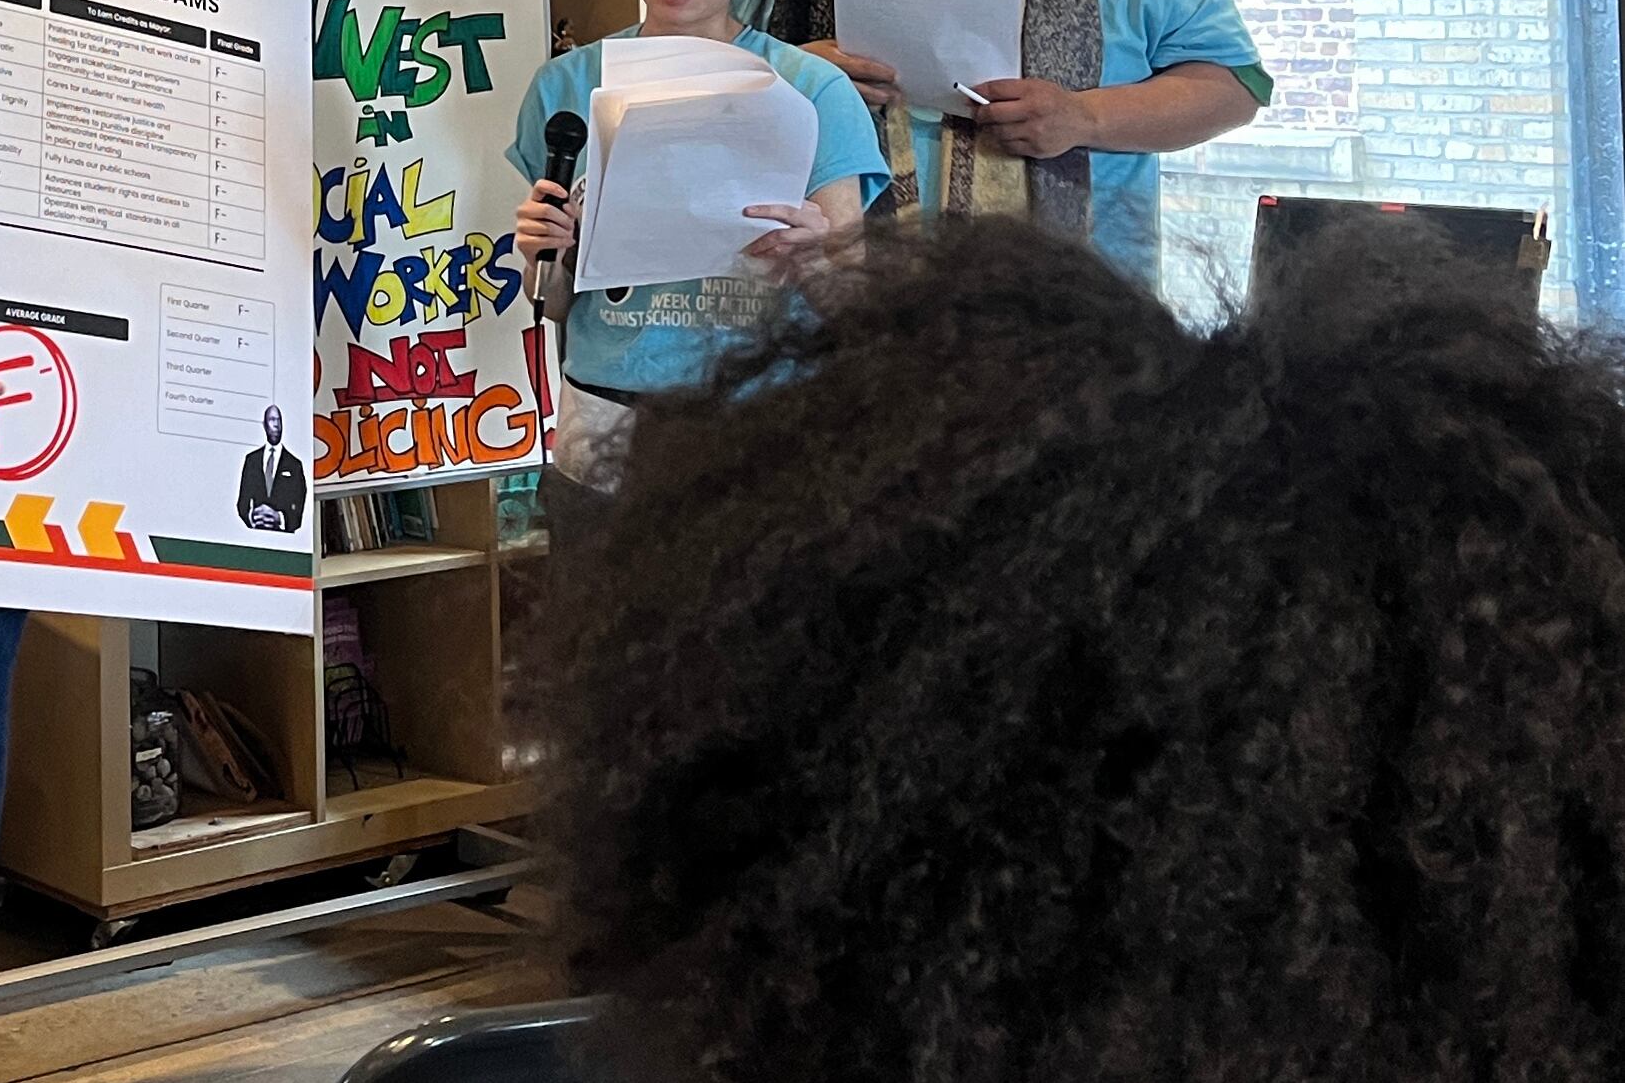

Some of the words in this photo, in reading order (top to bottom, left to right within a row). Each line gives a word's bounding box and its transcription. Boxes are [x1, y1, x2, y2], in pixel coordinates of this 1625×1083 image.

[87, 6, 97, 17] To
[97, 8, 113, 21] Earn
[114, 12, 139, 28] Credits
[139, 20, 148, 29] as
[48, 22, 78, 38] Protects
[80, 30, 104, 43] school
[105, 35, 140, 53] programs
[141, 44, 156, 55] that
[156, 49, 173, 59] work
[174, 52, 189, 62] and
[190, 56, 202, 65] are
[48, 34, 75, 50] healing
[77, 40, 88, 51] for
[89, 43, 120, 58] students
[217, 38, 233, 50] Final
[233, 42, 254, 55] Grade
[48, 49, 80, 65] Engages
[81, 56, 127, 74] stakeholders
[128, 66, 143, 76] and
[143, 71, 180, 87] empowers
[46, 78, 68, 90] Cares
[69, 82, 81, 93] for
[116, 92, 142, 106] mental
[143, 97, 166, 111] health
[106, 71, 131, 84] school
[131, 77, 174, 95] governance
[1, 93, 28, 107] Dignity
[46, 98, 91, 115] Implements
[92, 107, 131, 123] restorative
[132, 116, 156, 129] justice
[156, 122, 171, 132] and
[46, 109, 91, 126] alternatives
[91, 117, 100, 127] to
[100, 120, 130, 135] punitive
[130, 126, 164, 142] discipline
[46, 122, 98, 139] Demonstrates
[99, 131, 134, 148] openness
[135, 137, 150, 149] and
[150, 143, 198, 161] transparency
[53, 136, 77, 150] policy
[77, 139, 93, 151] and
[93, 143, 123, 159] funding
[45, 152, 63, 165] Fully
[63, 155, 85, 167] funds
[85, 160, 99, 169] our
[99, 161, 123, 176] public
[123, 168, 151, 181] schools
[45, 173, 83, 189] Advances
[118, 186, 140, 200] rights
[140, 191, 155, 201] and
[156, 196, 181, 207] access
[182, 200, 190, 208] to
[44, 196, 80, 212] Operates
[80, 202, 96, 214] with
[97, 205, 123, 219] ethical
[125, 211, 162, 227] standards
[163, 218, 170, 227] in
[171, 220, 181, 229] all
[314, 232, 522, 343] WORKERS
[167, 296, 182, 306] First
[183, 299, 210, 310] Quarter
[651, 293, 691, 310] WEEK
[695, 294, 715, 312] OF
[719, 296, 762, 314] ACTIO
[5, 307, 40, 321] AVERAGE
[40, 312, 66, 325] GRADE
[166, 329, 193, 341] Second
[194, 334, 221, 345] Quarter
[166, 361, 184, 372] Third
[185, 365, 212, 375] Quarter
[347, 328, 474, 406] NOT
[165, 391, 187, 401] Fourth
[188, 395, 214, 405] Quarter
